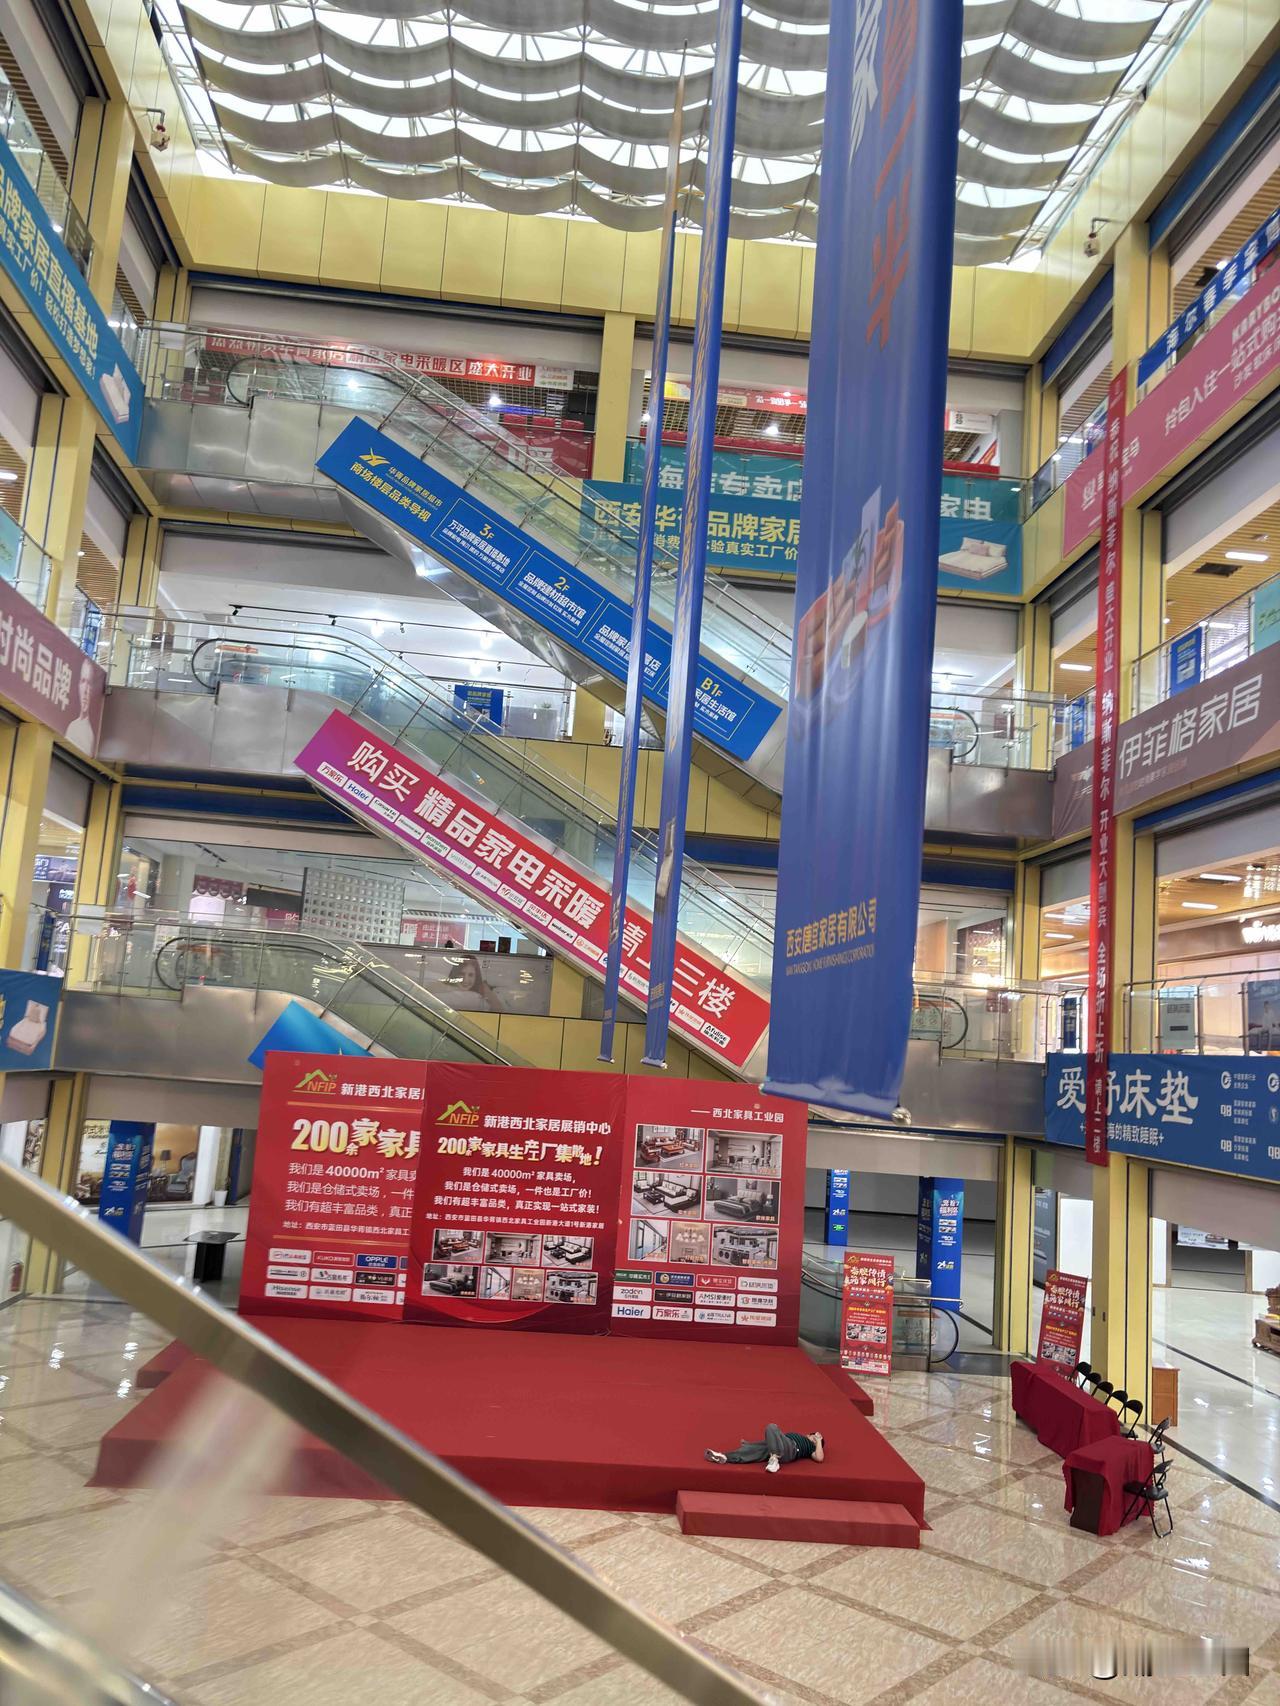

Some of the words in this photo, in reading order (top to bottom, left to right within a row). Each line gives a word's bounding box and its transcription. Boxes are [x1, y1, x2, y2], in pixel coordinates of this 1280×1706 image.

[0, 163, 99, 360] 牌家居直播基地
[467, 361, 532, 383] 盛大开业
[1164, 314, 1280, 436] 拎包入住一站式购
[350, 462, 432, 523] 商场楼层品类导视
[940, 494, 994, 521] 家电
[479, 524, 495, 539] 3F
[706, 540, 798, 561] 验真实工厂价
[554, 576, 570, 591] 2F
[523, 571, 587, 620] 品牌建材超市馆
[702, 677, 723, 697] B1F
[1119, 673, 1263, 780] 伊菲格家居
[347, 782, 370, 801] Haier
[347, 740, 420, 801] 购买
[413, 786, 605, 930] 精品家电采暖
[621, 919, 736, 1018] 请三楼
[308, 1080, 337, 1093] NFIP
[341, 1082, 425, 1101] 新港西北家居
[450, 1112, 479, 1125] NFIP
[484, 1115, 611, 1135] 新港西北家居展销中心
[288, 1162, 325, 1176] 我们是
[463, 1167, 490, 1178] 我们是
[617, 1307, 644, 1316] Haier
[655, 1308, 680, 1317] 万家乐
